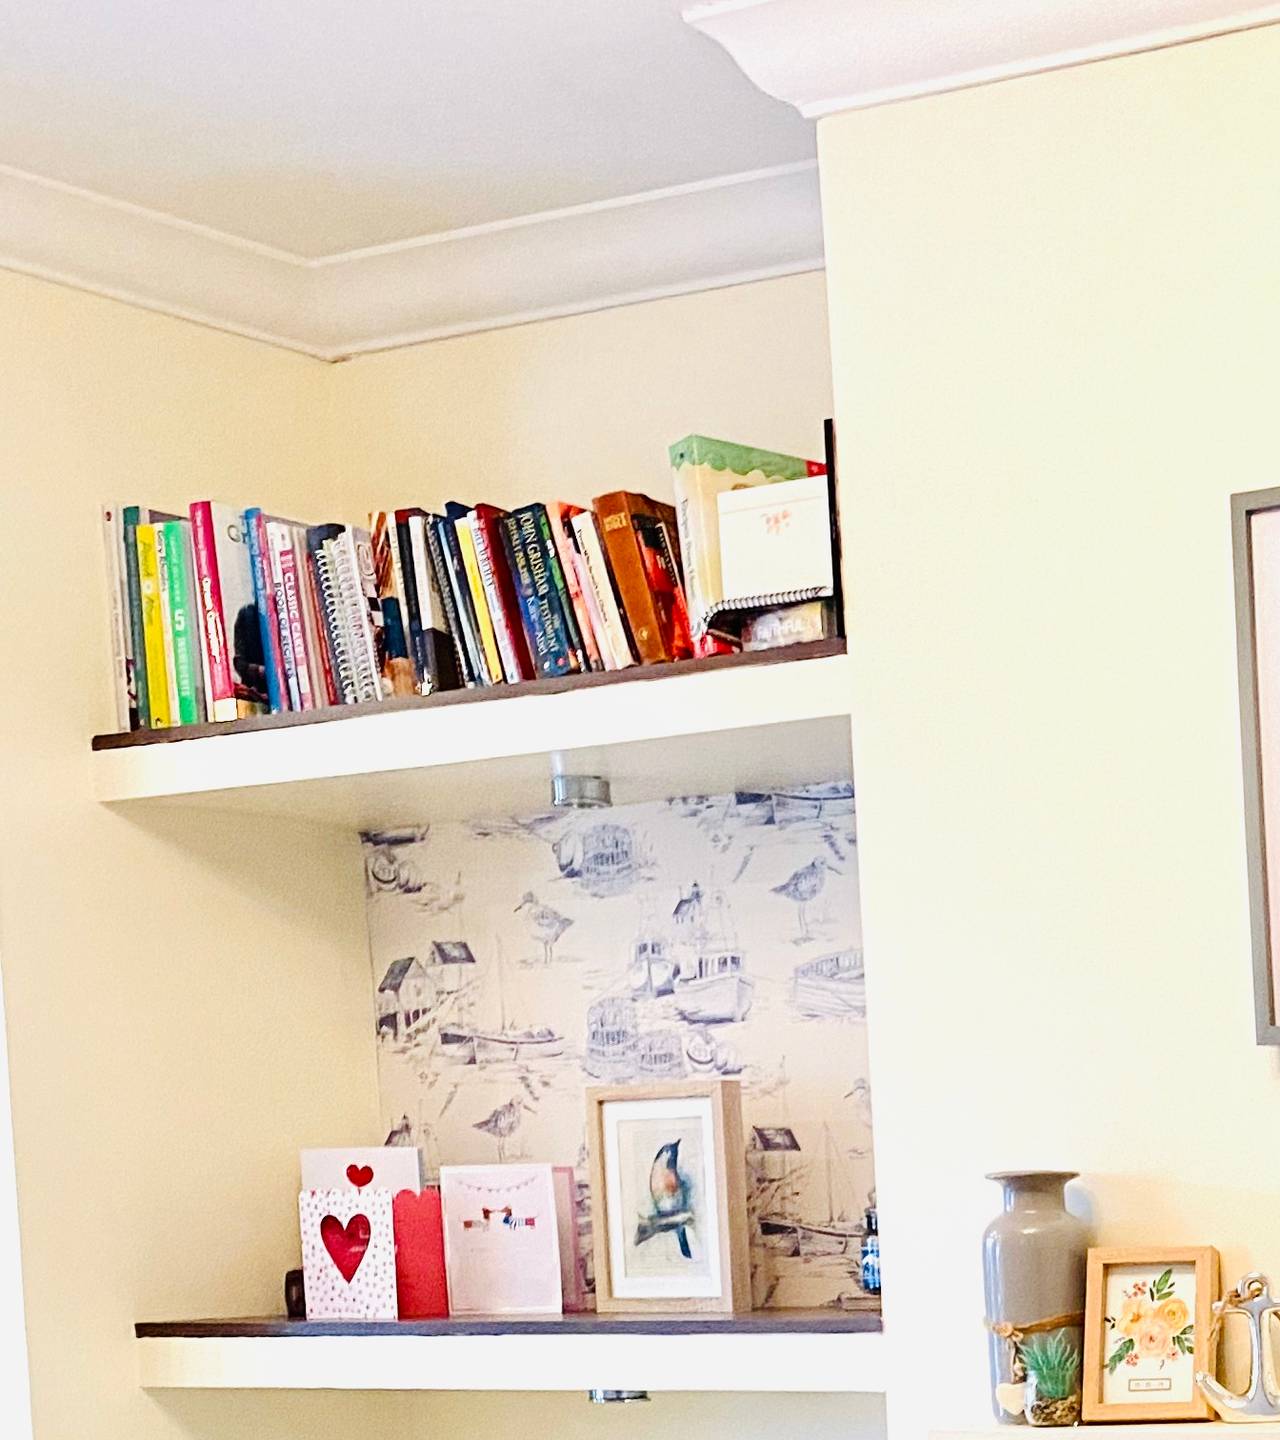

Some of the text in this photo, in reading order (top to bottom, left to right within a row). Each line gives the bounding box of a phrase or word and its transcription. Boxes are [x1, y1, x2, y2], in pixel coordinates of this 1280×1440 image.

[518, 512, 550, 596] JOHN GRISHAM
[174, 608, 186, 632] 5
[273, 582, 287, 614] BOOK
[538, 597, 560, 653] TESTAMENT
